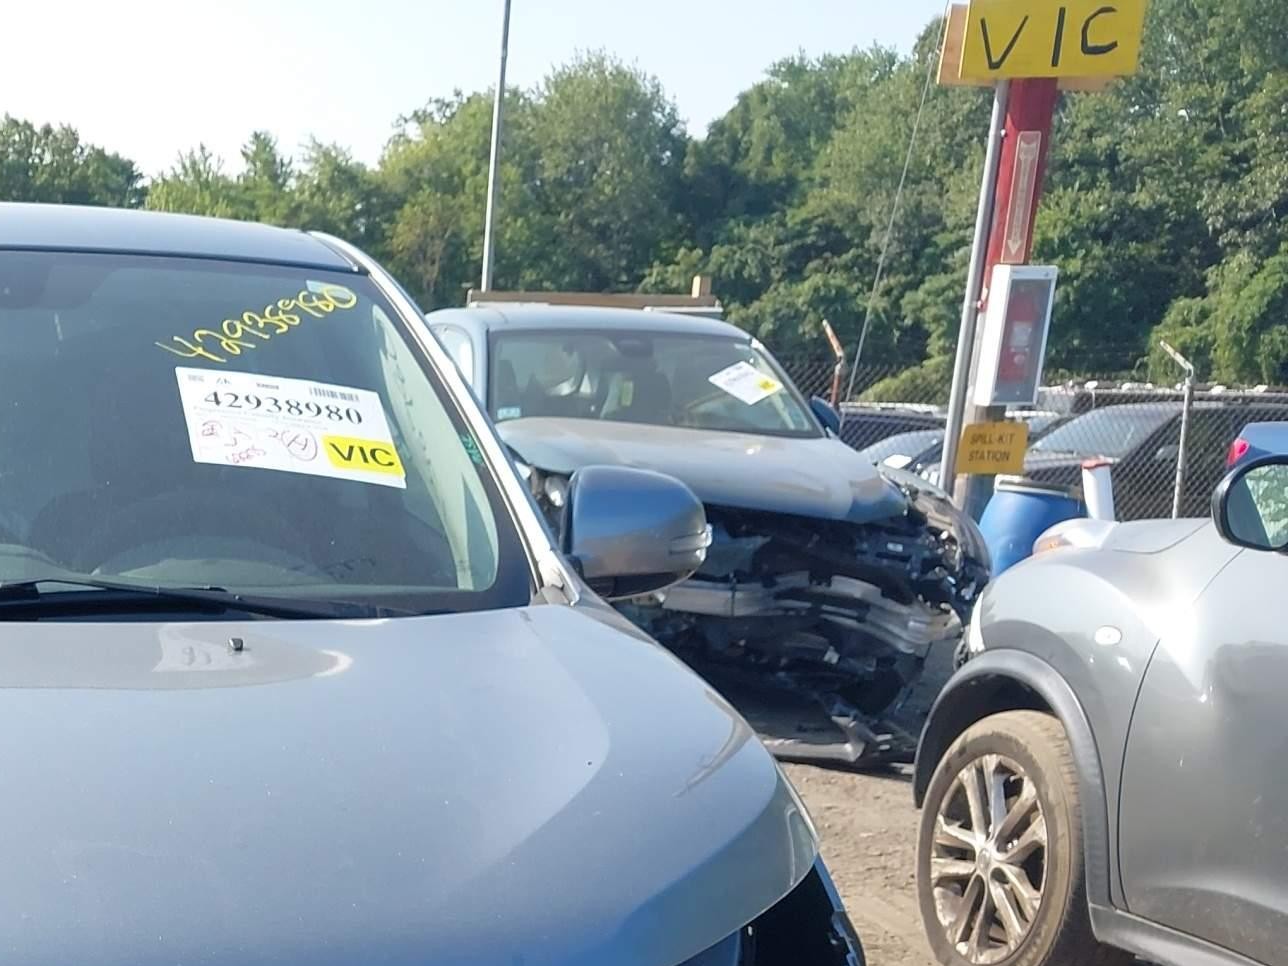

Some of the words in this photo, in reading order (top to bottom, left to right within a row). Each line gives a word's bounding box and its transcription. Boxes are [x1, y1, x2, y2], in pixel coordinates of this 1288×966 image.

[979, 6, 1118, 70] VIC
[204, 391, 363, 425] 42938980
[969, 432, 1016, 445] SPILL-KIT
[329, 441, 396, 467] VIC
[968, 450, 1011, 462] STATION
